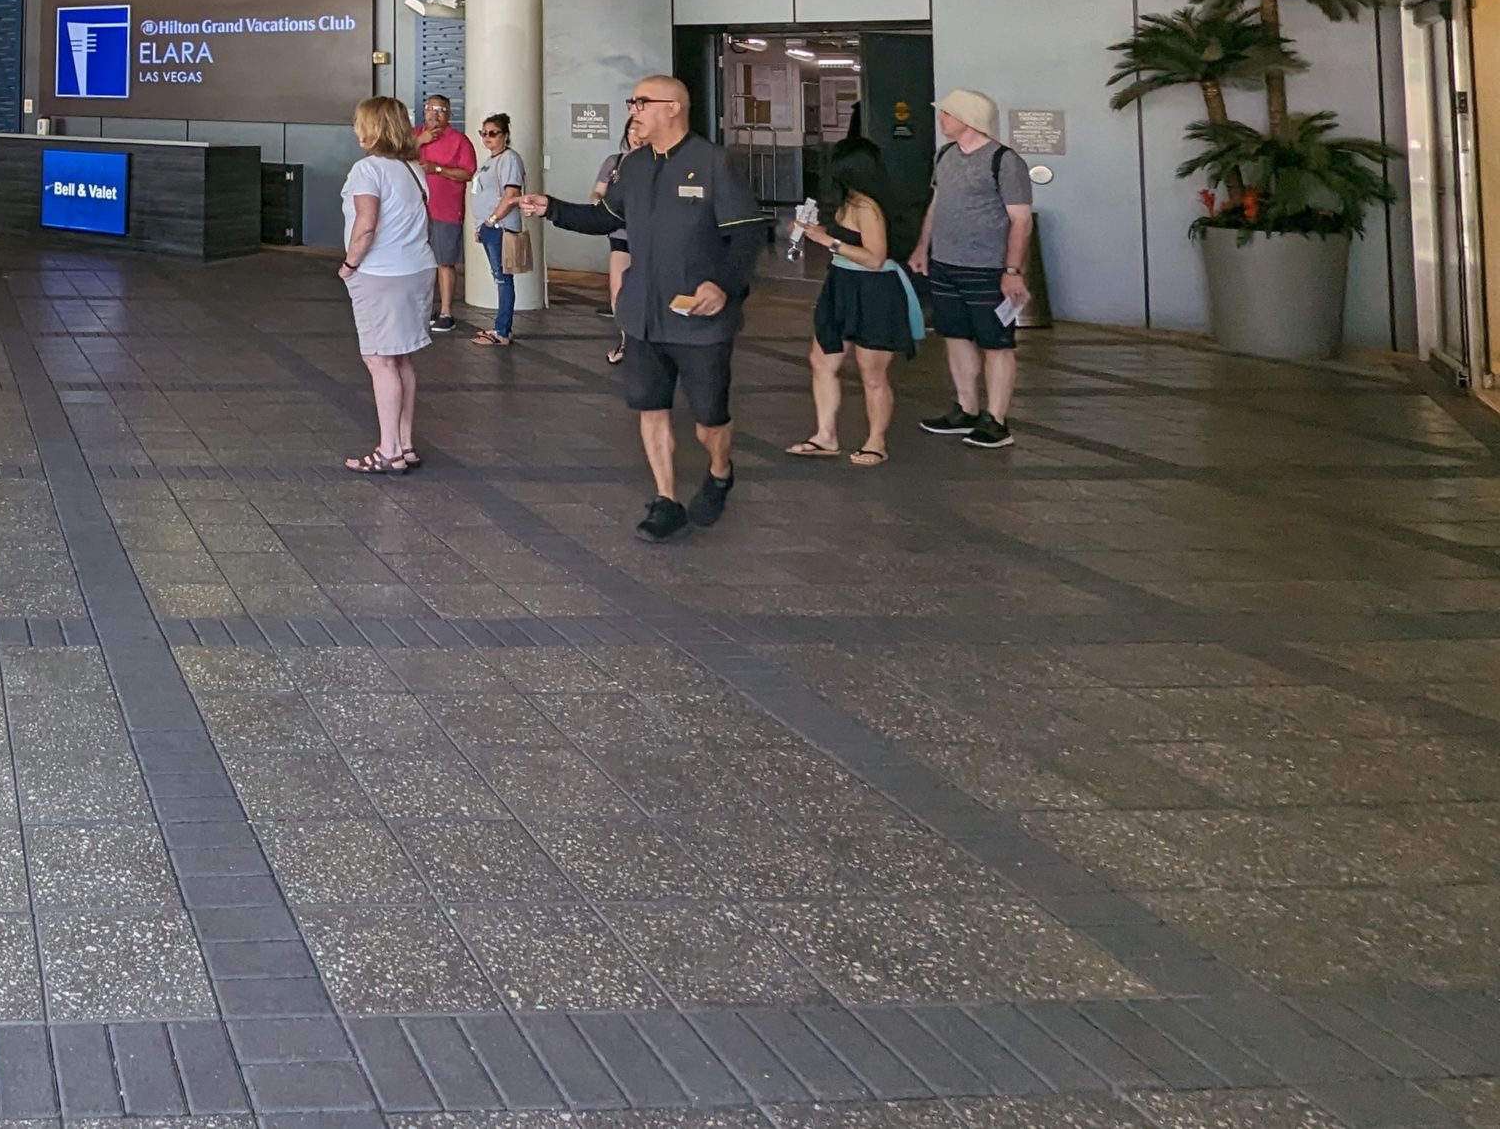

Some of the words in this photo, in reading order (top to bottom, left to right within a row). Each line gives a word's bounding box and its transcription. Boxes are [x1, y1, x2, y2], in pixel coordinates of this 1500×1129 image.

[158, 20, 200, 35] Hilton
[202, 19, 244, 34] Grand
[245, 17, 316, 33] Vacations
[318, 15, 356, 31] Club
[139, 41, 214, 64] ELARA
[139, 71, 159, 82] LAS
[162, 71, 203, 83] VEGAS
[54, 181, 76, 197] Bell
[77, 183, 87, 198] &
[88, 183, 117, 200] Valet
